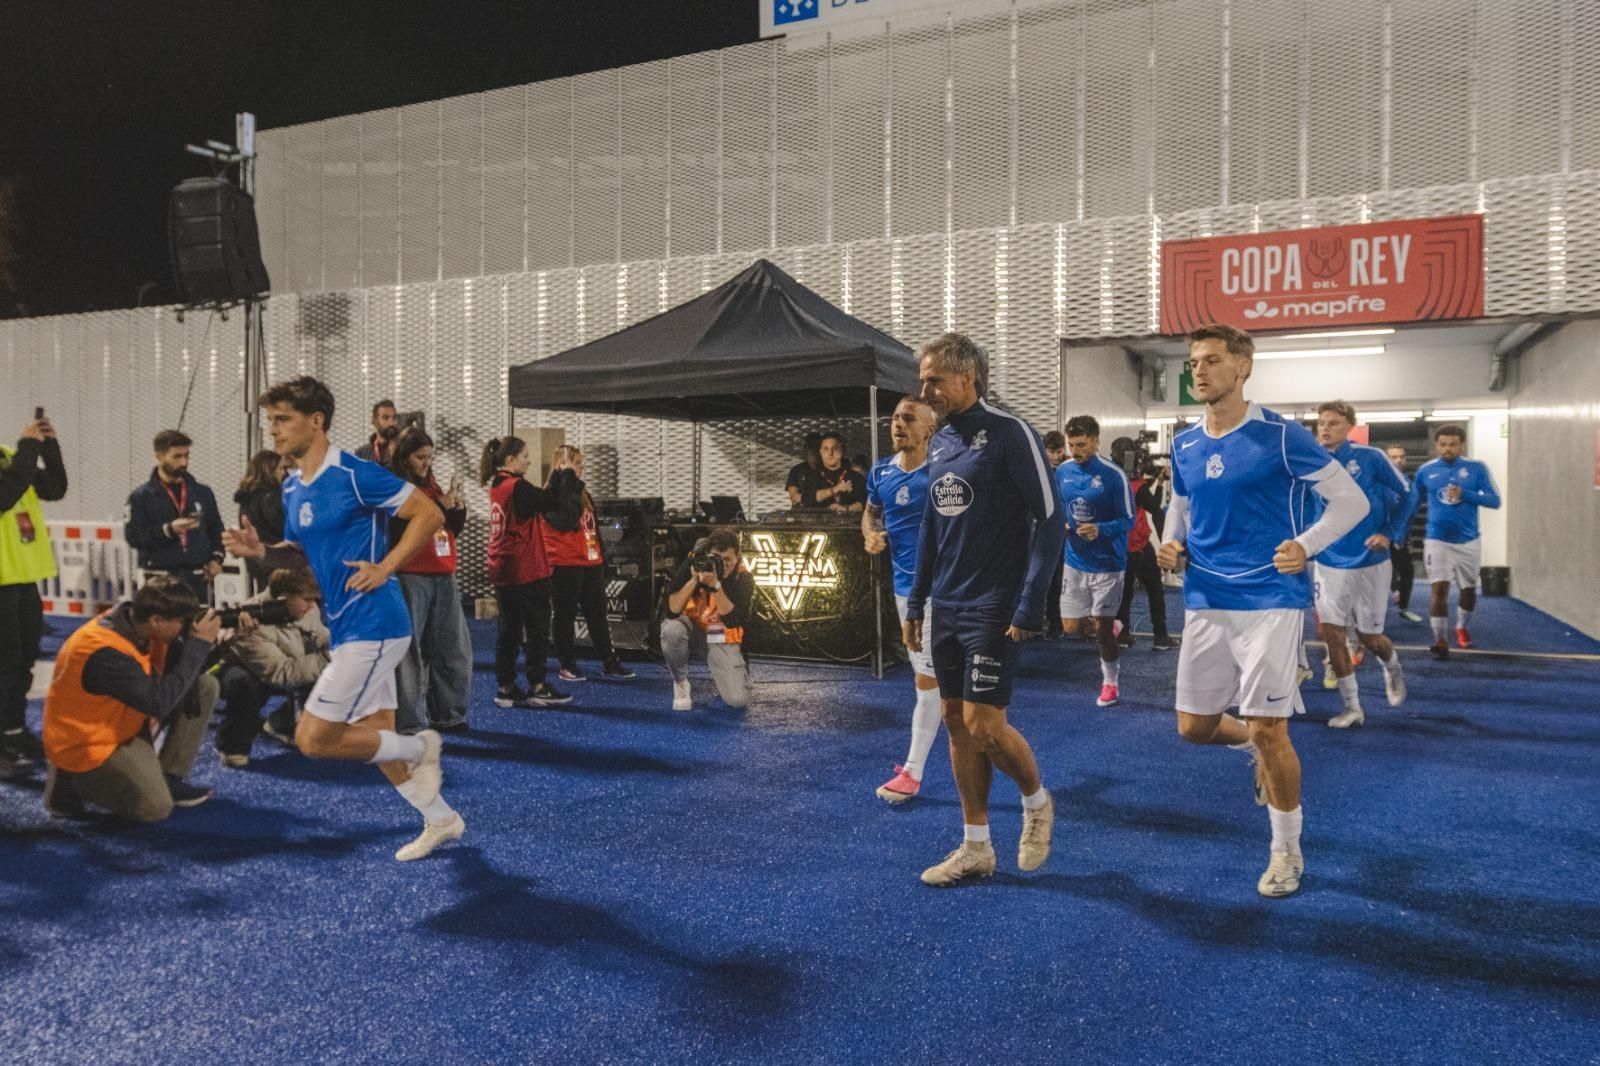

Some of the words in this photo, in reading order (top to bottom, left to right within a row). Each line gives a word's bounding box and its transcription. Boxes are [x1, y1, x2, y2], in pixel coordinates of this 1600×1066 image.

[1221, 243, 1302, 296] COPA
[1312, 280, 1339, 289] DEL
[1350, 234, 1412, 287] REY
[1283, 294, 1386, 318] mapfre
[935, 484, 963, 495] Estrella
[937, 495, 963, 505] Galicia
[742, 556, 836, 576] VERBENA
